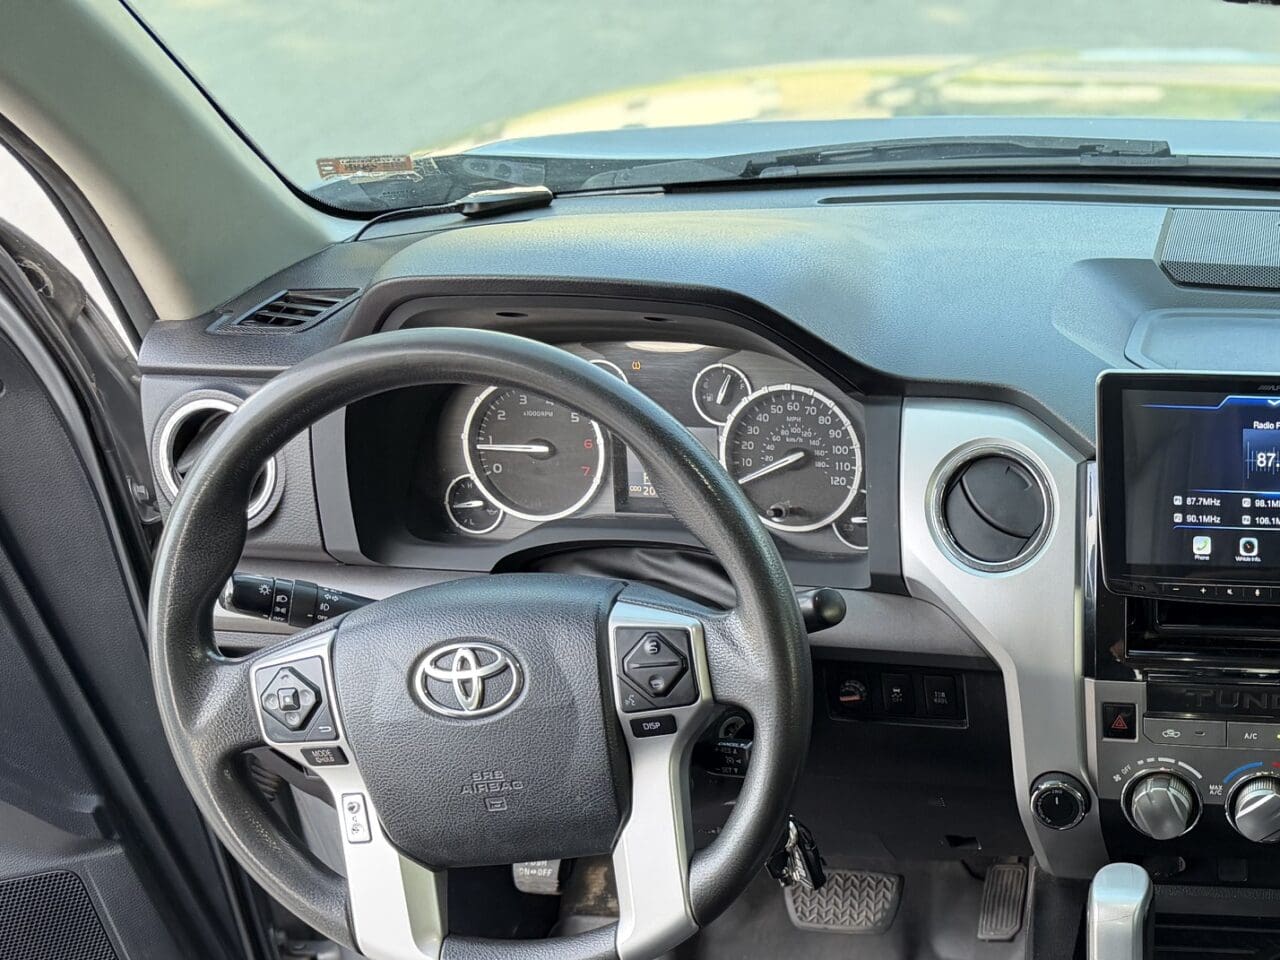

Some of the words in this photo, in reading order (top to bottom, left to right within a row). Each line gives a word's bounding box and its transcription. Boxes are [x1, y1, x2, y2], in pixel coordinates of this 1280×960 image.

[519, 394, 528, 405] 3
[770, 405, 783, 414] 50
[786, 402, 800, 411] 60
[804, 406, 817, 416] 70
[497, 409, 506, 421] 2
[570, 412, 580, 423] 5
[756, 413, 769, 422] 40
[818, 416, 831, 425] 80
[1253, 421, 1275, 430] Radio
[747, 425, 760, 435] 30
[828, 429, 842, 439] 90
[583, 439, 593, 449] 6
[741, 441, 754, 450] 20
[832, 445, 849, 455] 100
[742, 458, 753, 467] 10
[835, 462, 851, 471] 110
[493, 463, 502, 474] 0
[581, 466, 591, 476] 7
[830, 476, 846, 486] 120
[1186, 497, 1221, 507] 87.7MHz
[1186, 514, 1221, 524] 90.1MHz
[642, 721, 661, 730] DISP
[1243, 732, 1258, 740] A/C
[471, 770, 504, 781] SRS
[461, 781, 524, 795] AIRBAG
